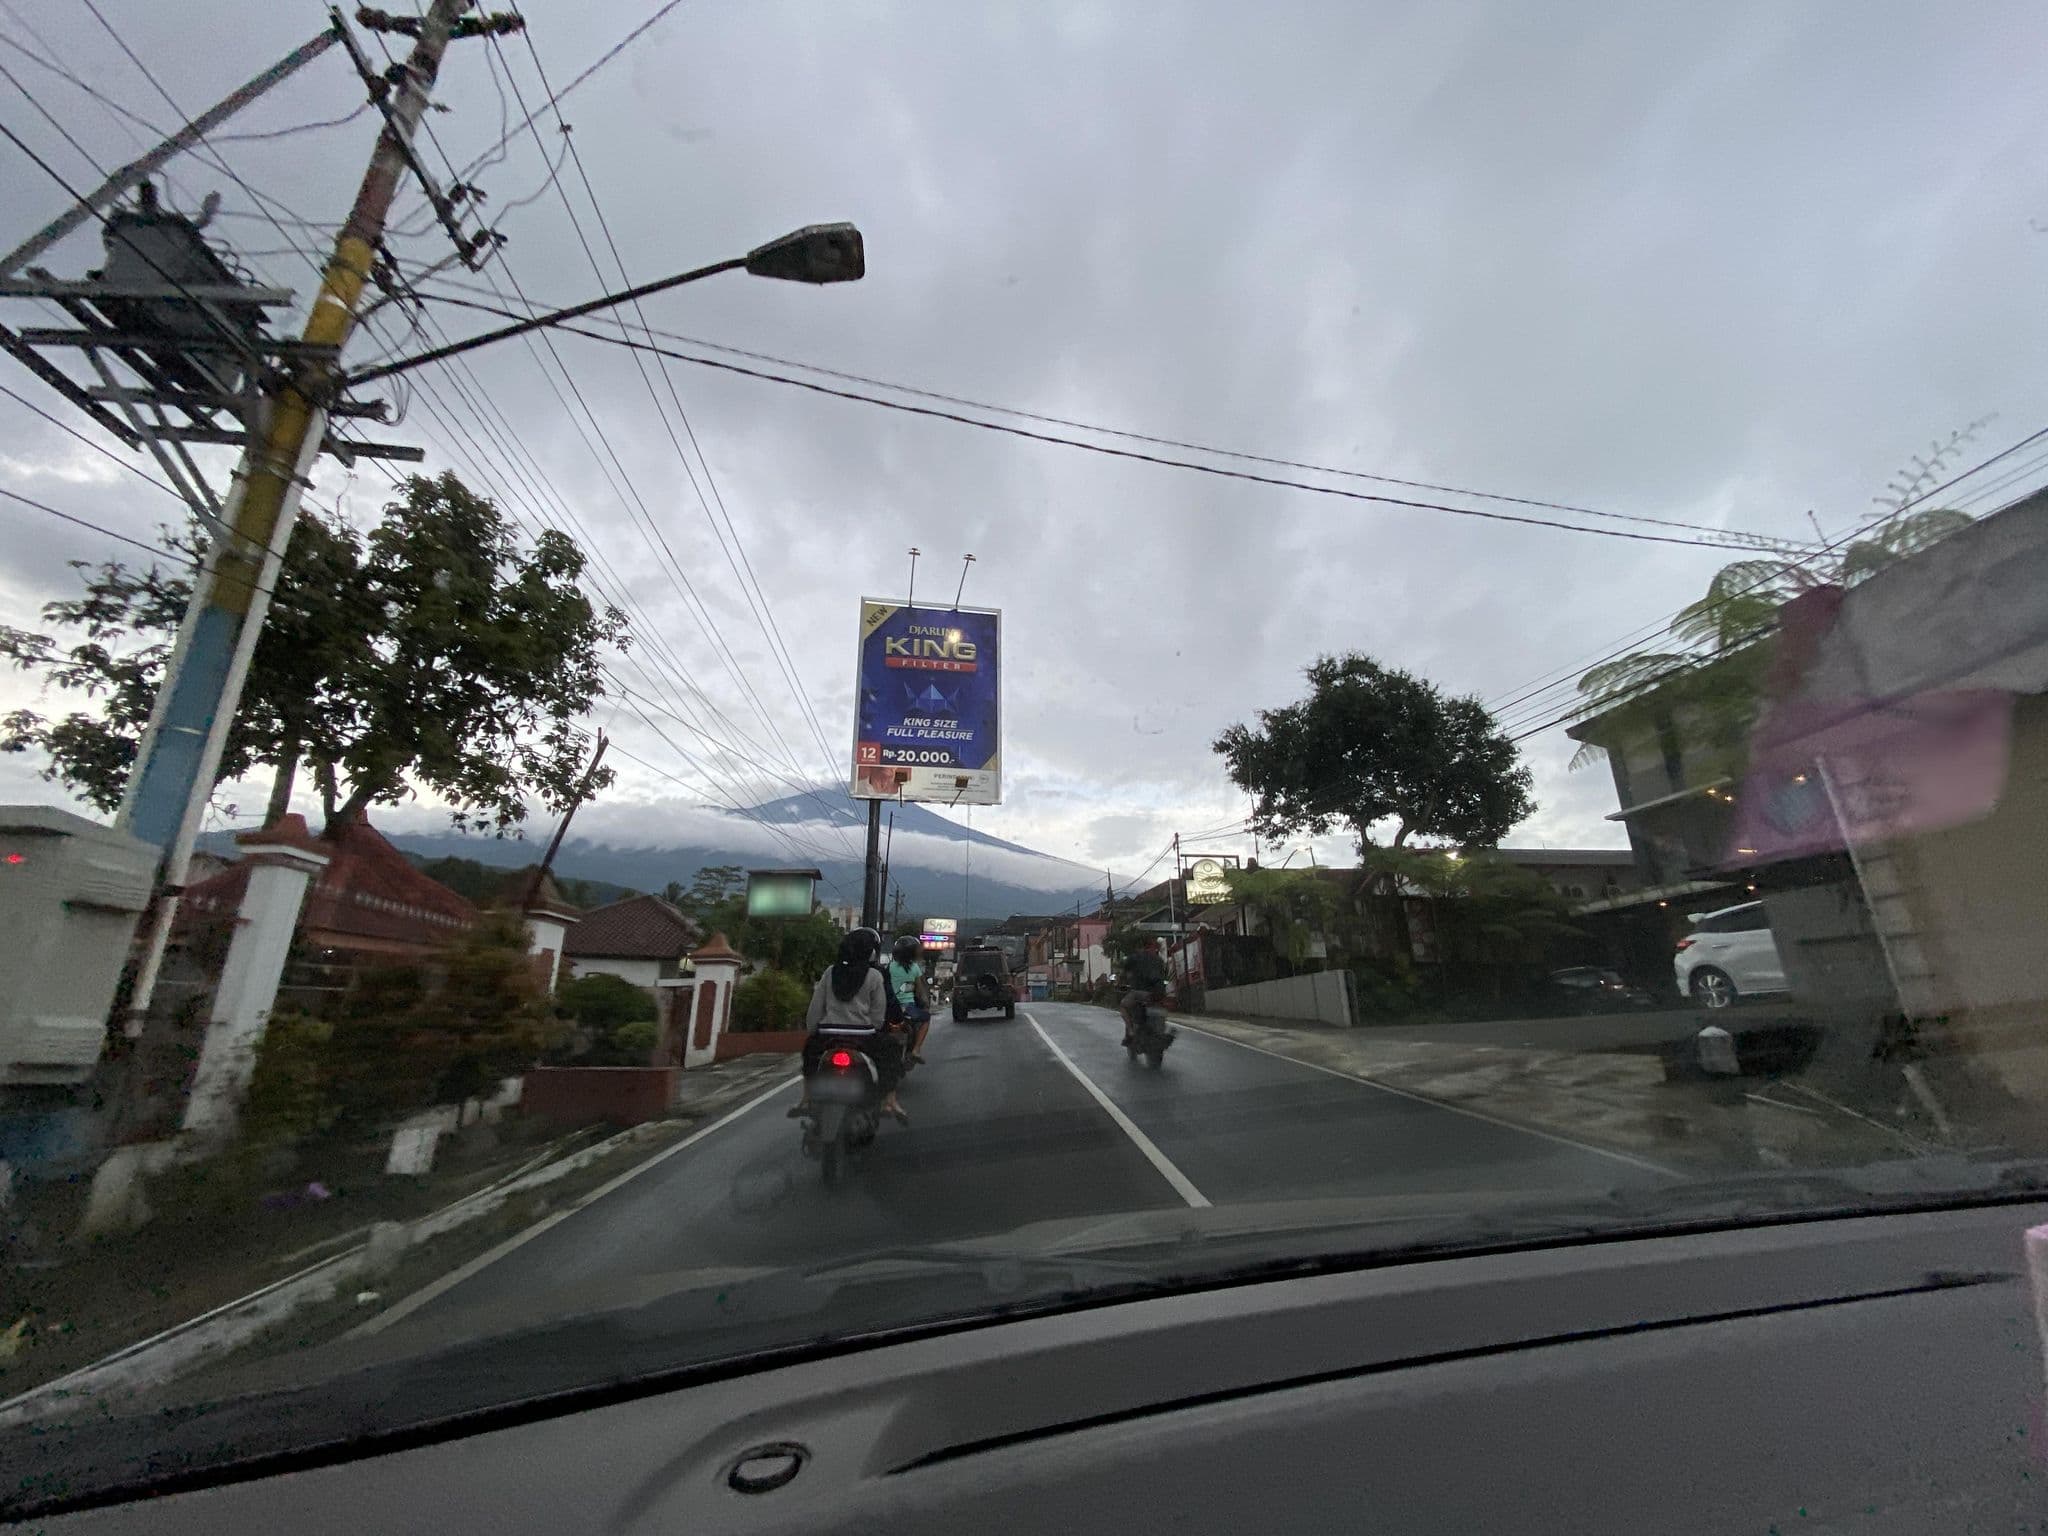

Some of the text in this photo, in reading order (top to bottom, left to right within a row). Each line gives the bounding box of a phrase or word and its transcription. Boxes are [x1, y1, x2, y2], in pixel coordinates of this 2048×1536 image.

[866, 606, 889, 627] NEW
[885, 636, 977, 660] KING
[901, 659, 962, 671] FILTER
[903, 717, 958, 729] KING SIZE
[886, 729, 974, 741] FULL PLEASURE
[861, 747, 877, 759] 12
